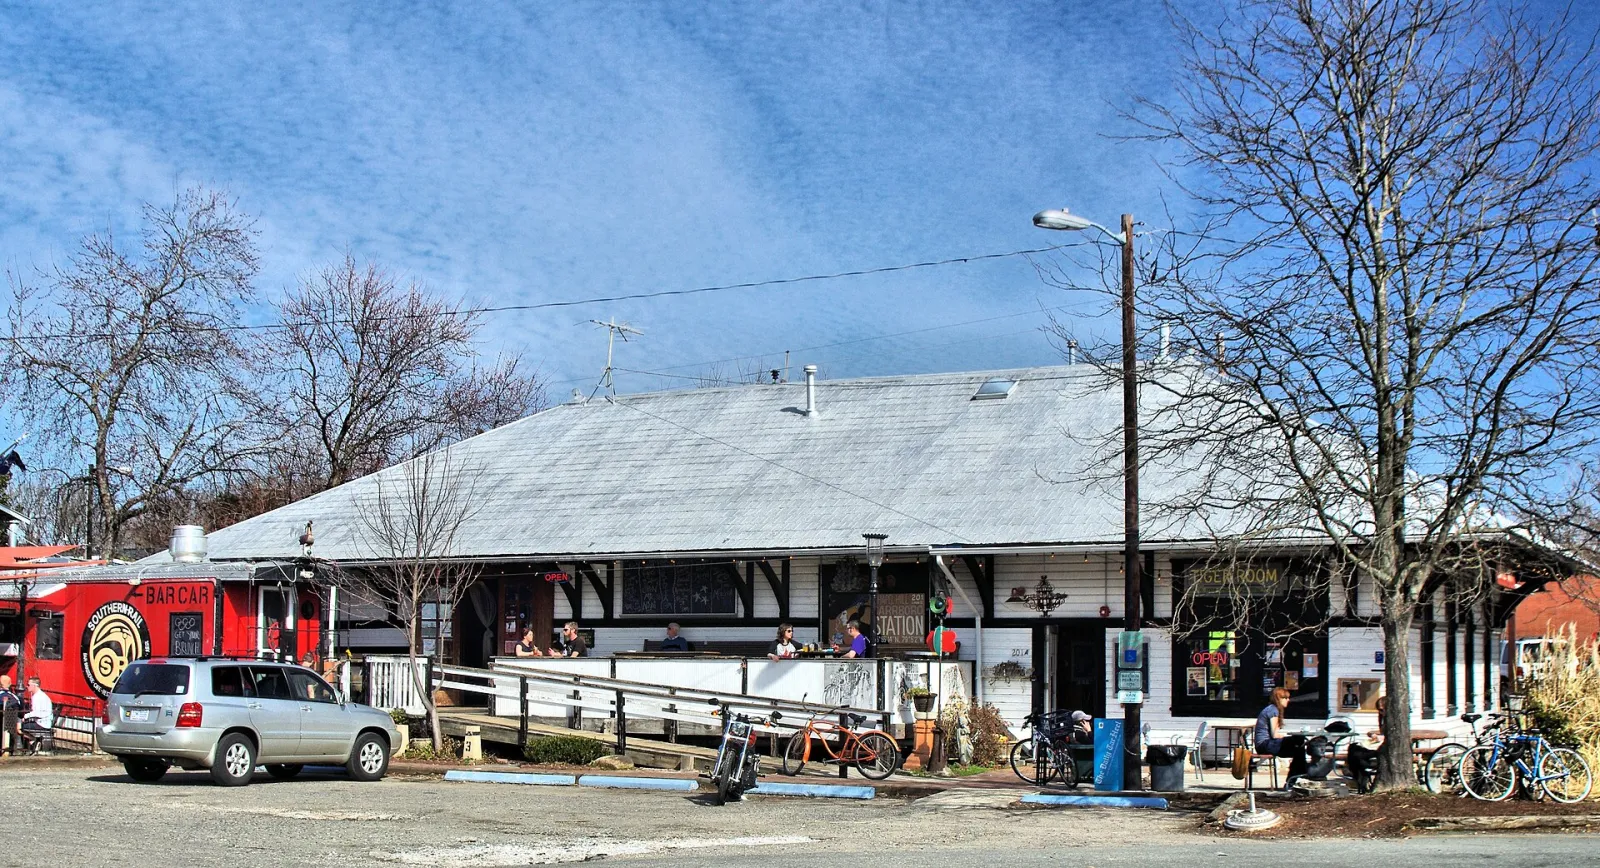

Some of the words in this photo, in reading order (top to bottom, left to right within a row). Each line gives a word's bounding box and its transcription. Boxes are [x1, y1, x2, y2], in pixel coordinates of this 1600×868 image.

[544, 573, 568, 581] OPEN
[1236, 568, 1278, 583] ROOM
[146, 586, 175, 605] BAR
[178, 585, 209, 604] CAR
[877, 604, 924, 615] ARRBORO
[876, 615, 924, 636] STATION
[1192, 652, 1229, 665] OPEN
[465, 741, 472, 752] 3
